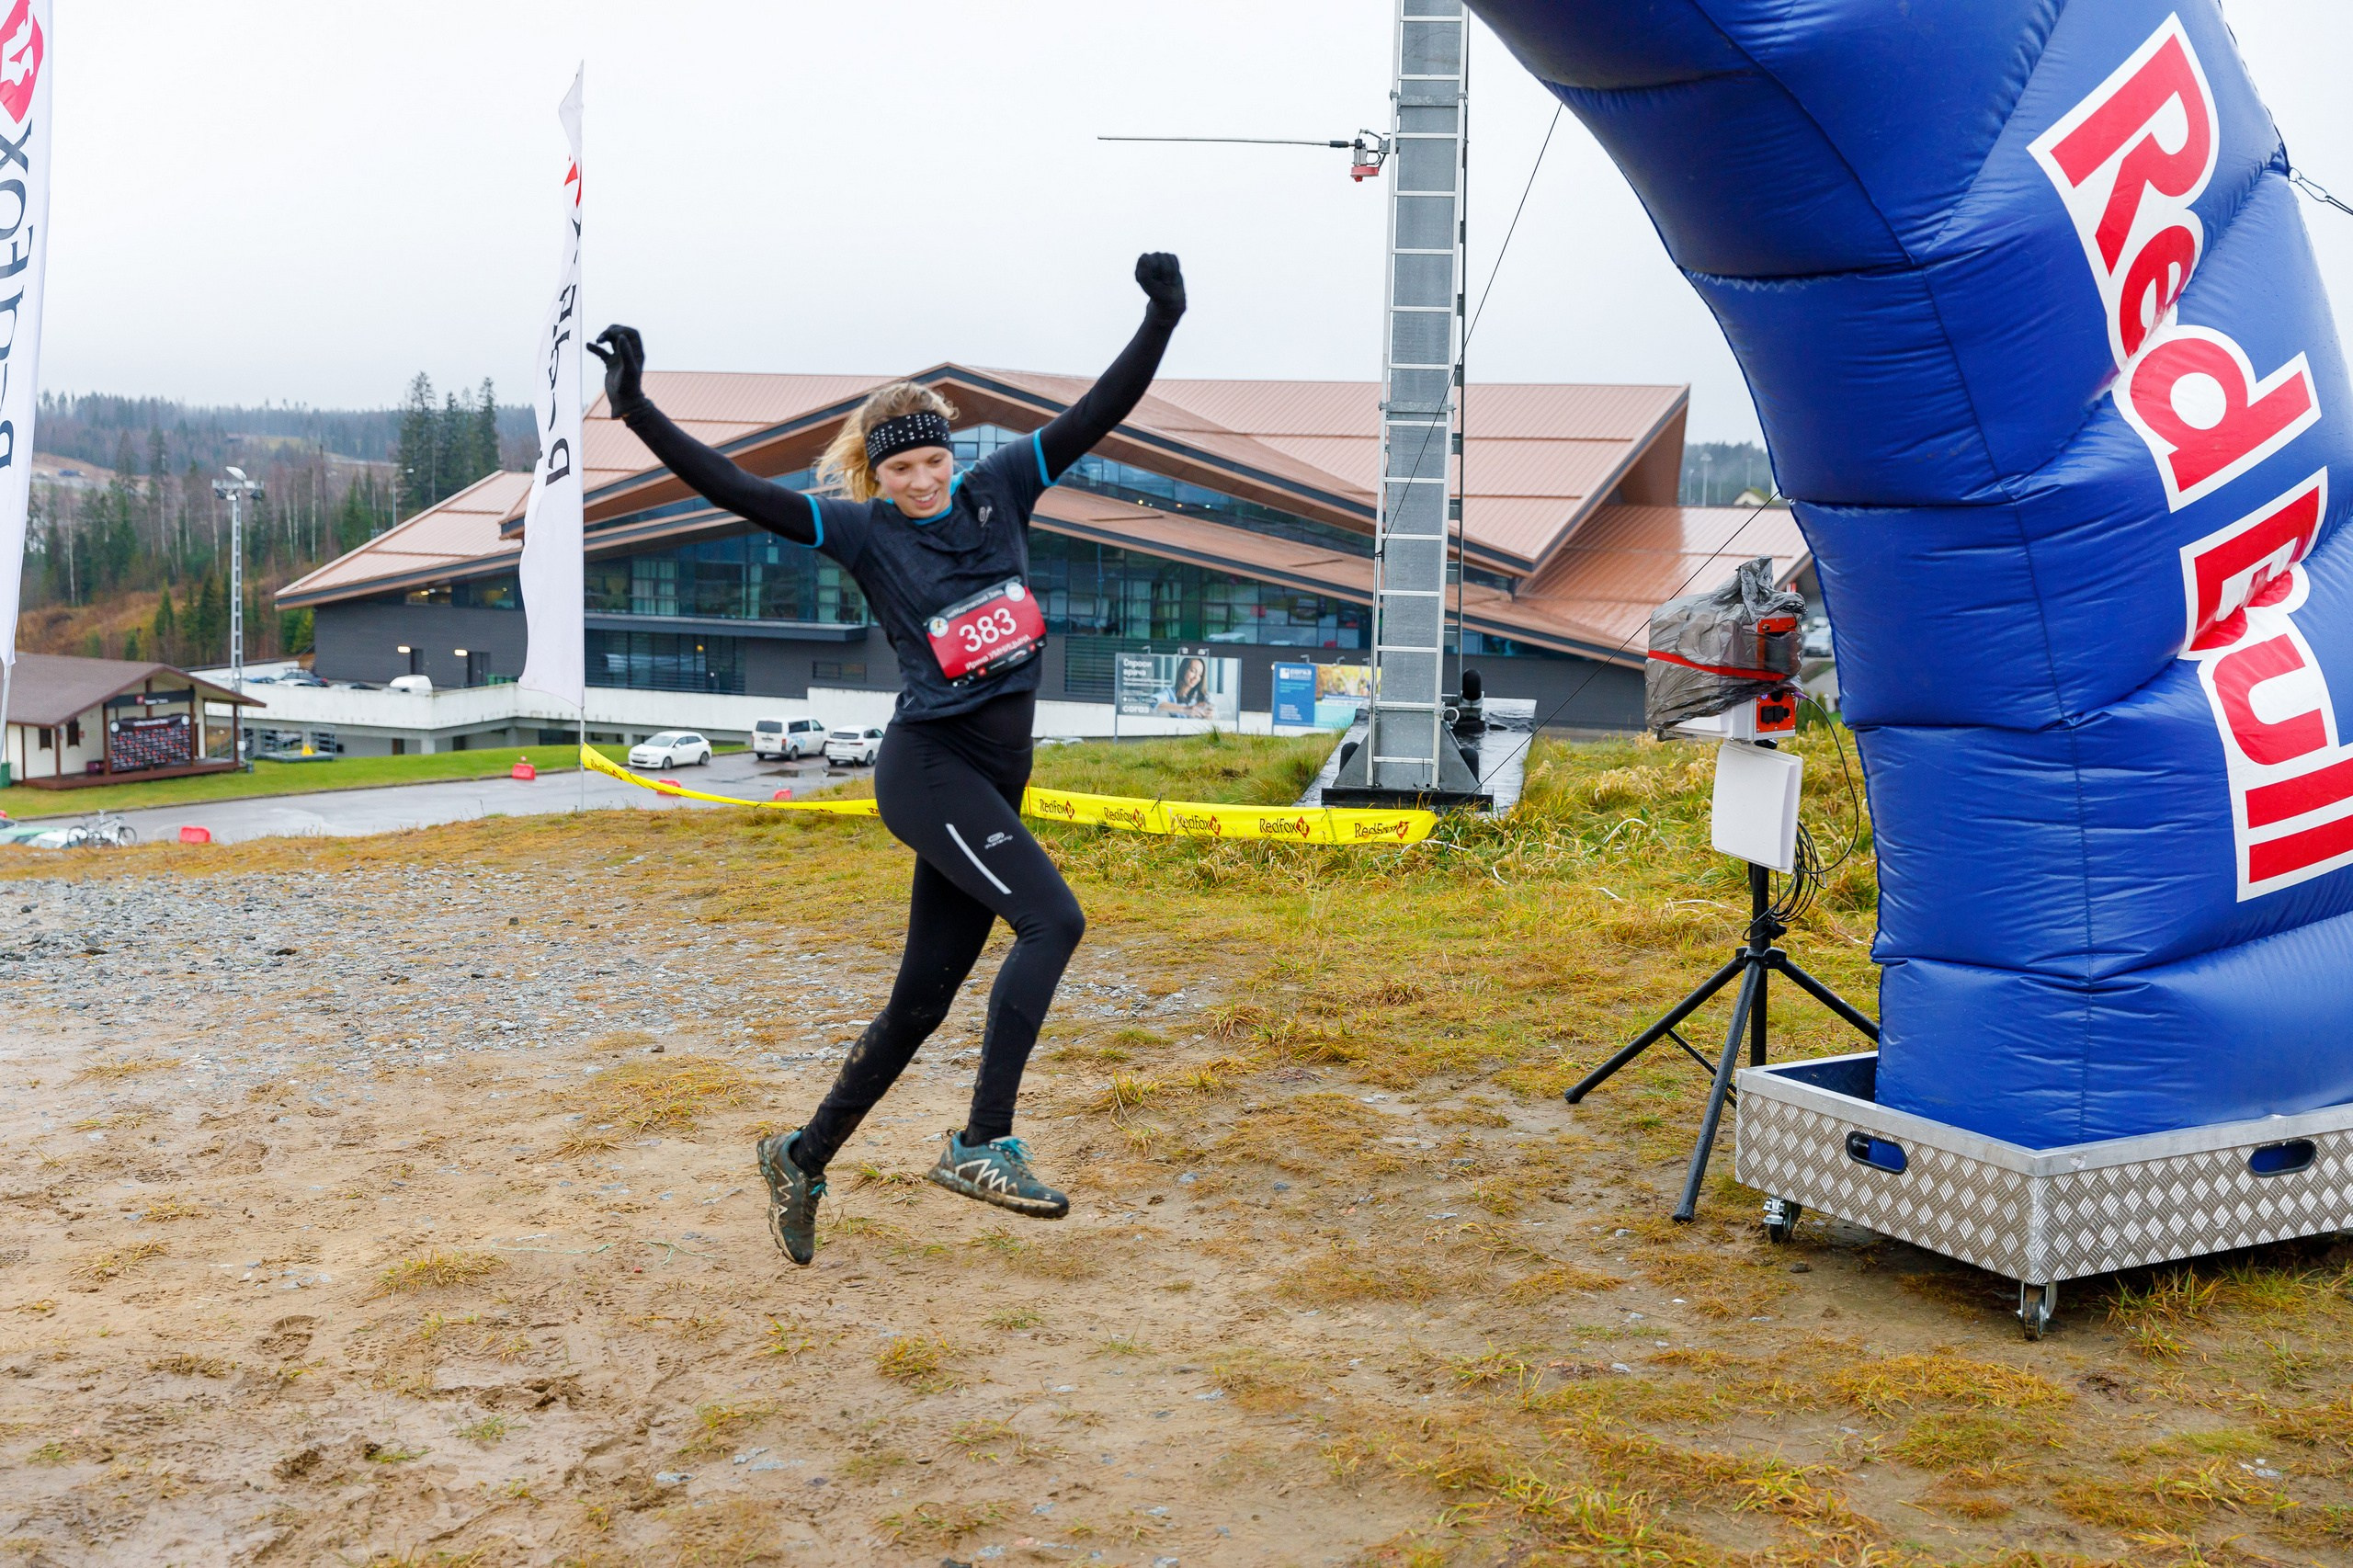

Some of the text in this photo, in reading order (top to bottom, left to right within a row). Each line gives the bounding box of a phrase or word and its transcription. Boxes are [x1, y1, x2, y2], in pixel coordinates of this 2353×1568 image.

[2044, 29, 2353, 888] Red Bull
[959, 608, 1017, 653] 383
[964, 654, 989, 671] Ирина
[1039, 798, 1067, 815] RedFox
[1103, 806, 1135, 823] RedFox
[1259, 817, 1298, 834] RedFox
